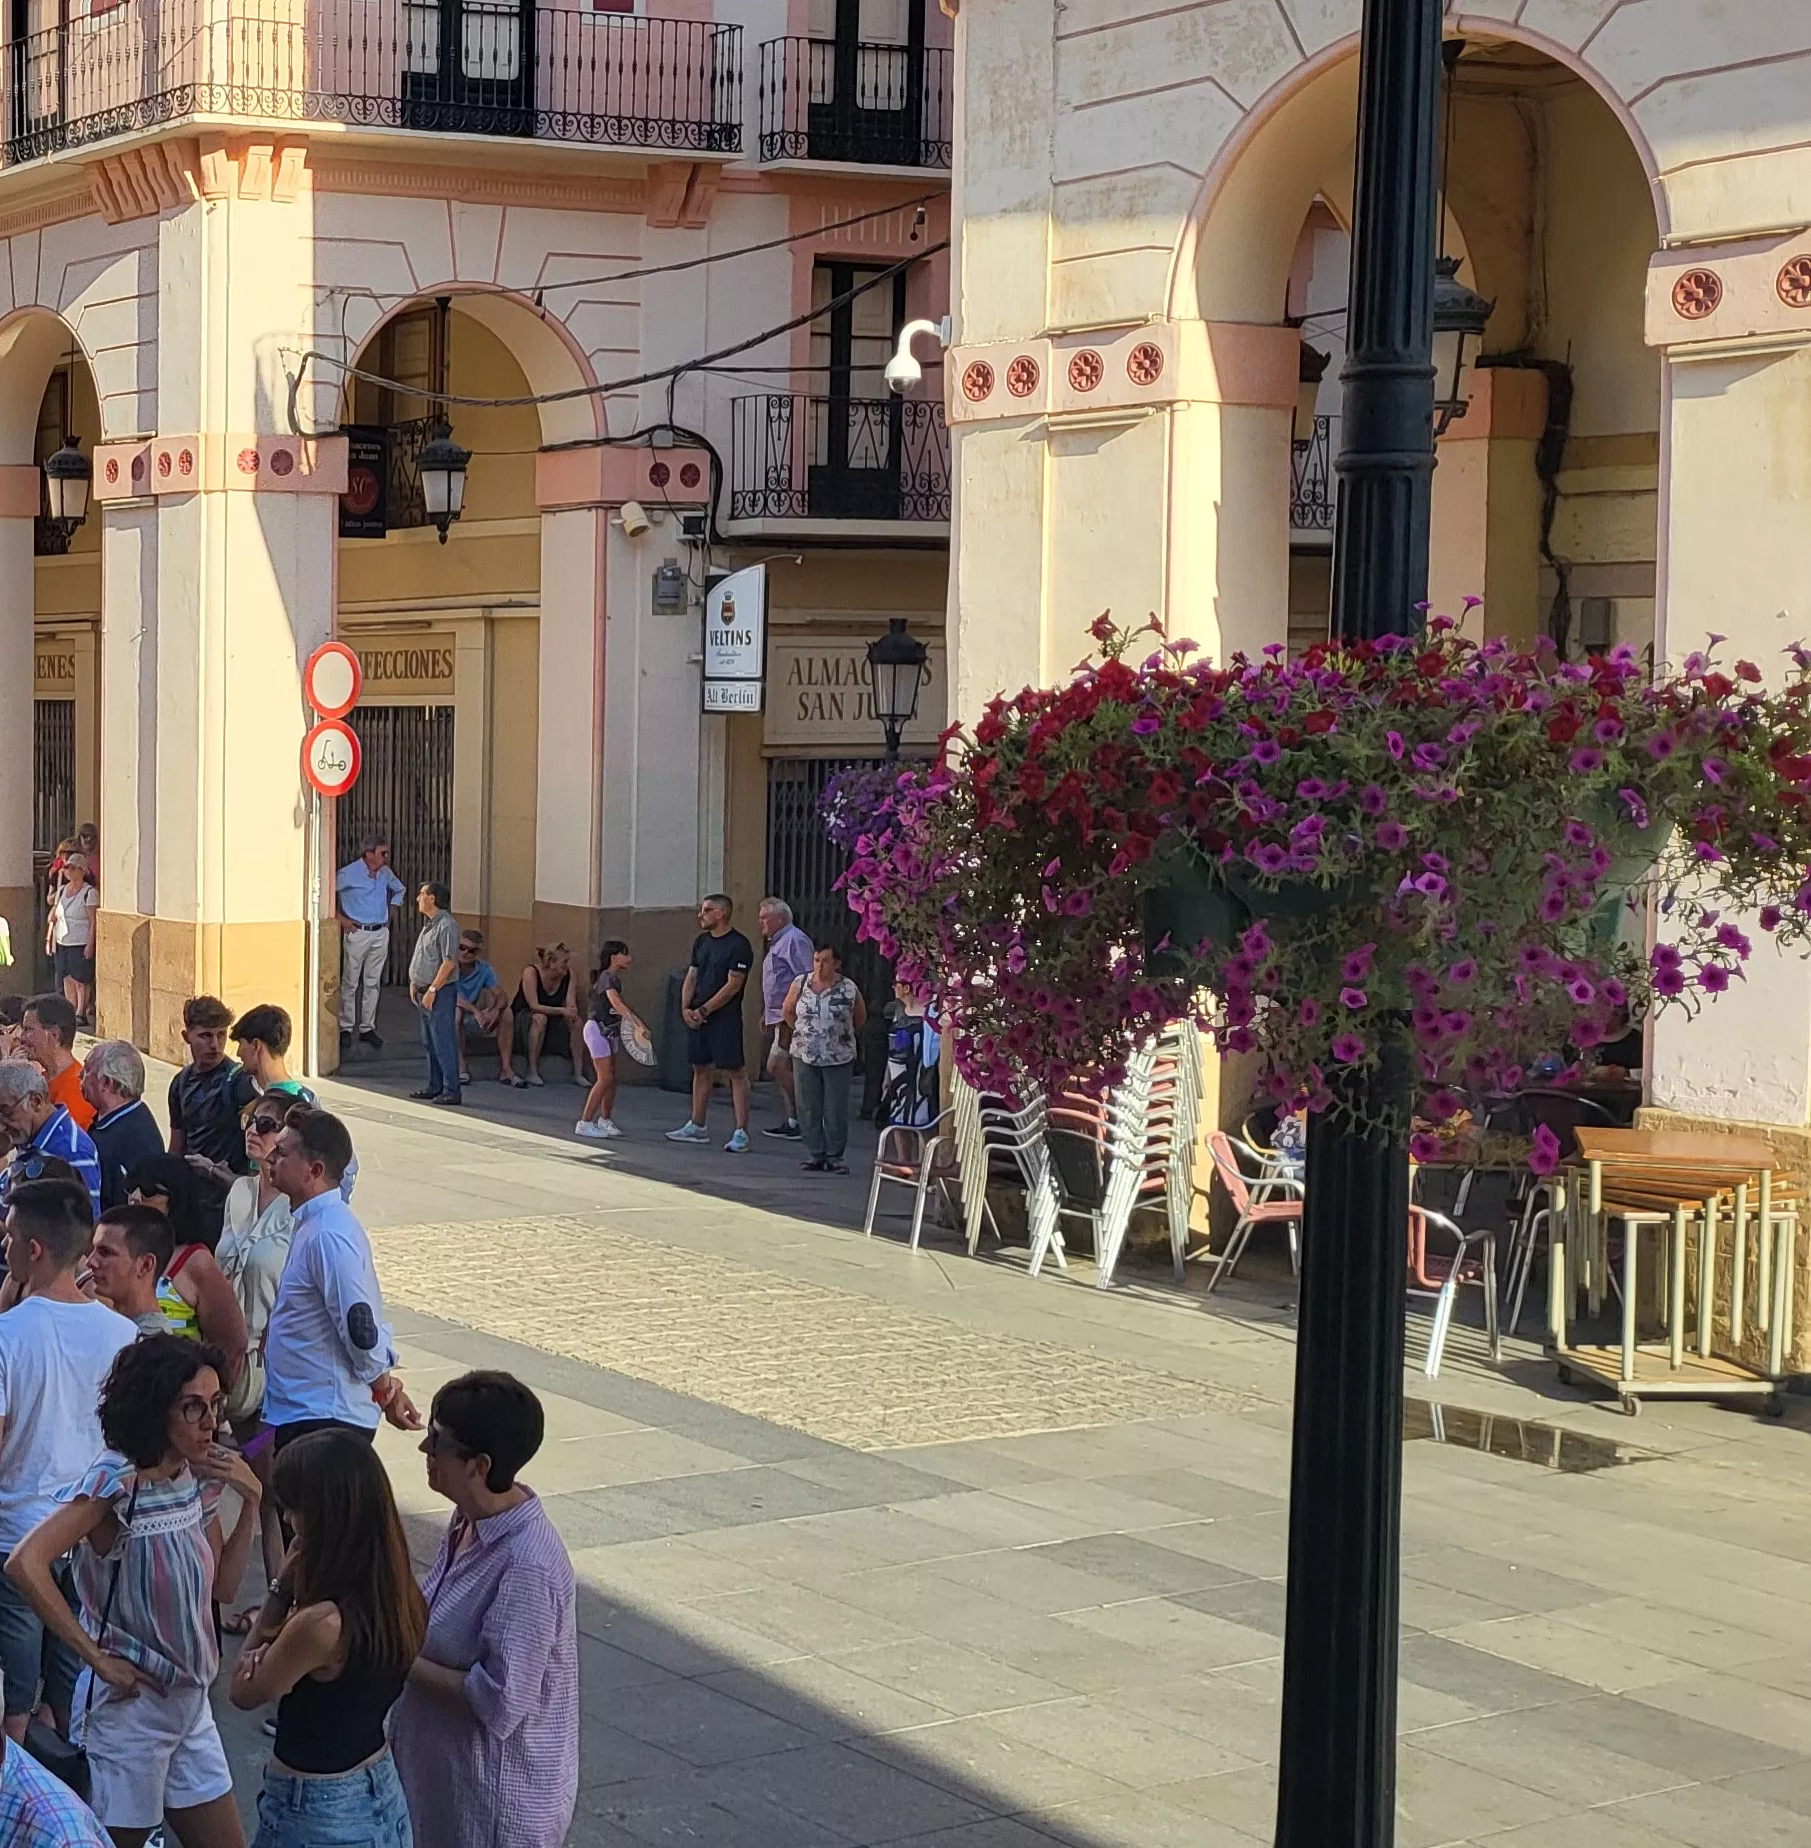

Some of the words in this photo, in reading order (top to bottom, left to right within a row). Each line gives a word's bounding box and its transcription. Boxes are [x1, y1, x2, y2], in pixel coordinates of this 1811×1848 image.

[710, 629, 752, 646] VELTINS
[34, 654, 75, 679] ENES
[788, 657, 933, 686] ALMACS
[707, 688, 718, 703] Alt
[797, 692, 844, 720] SAN
